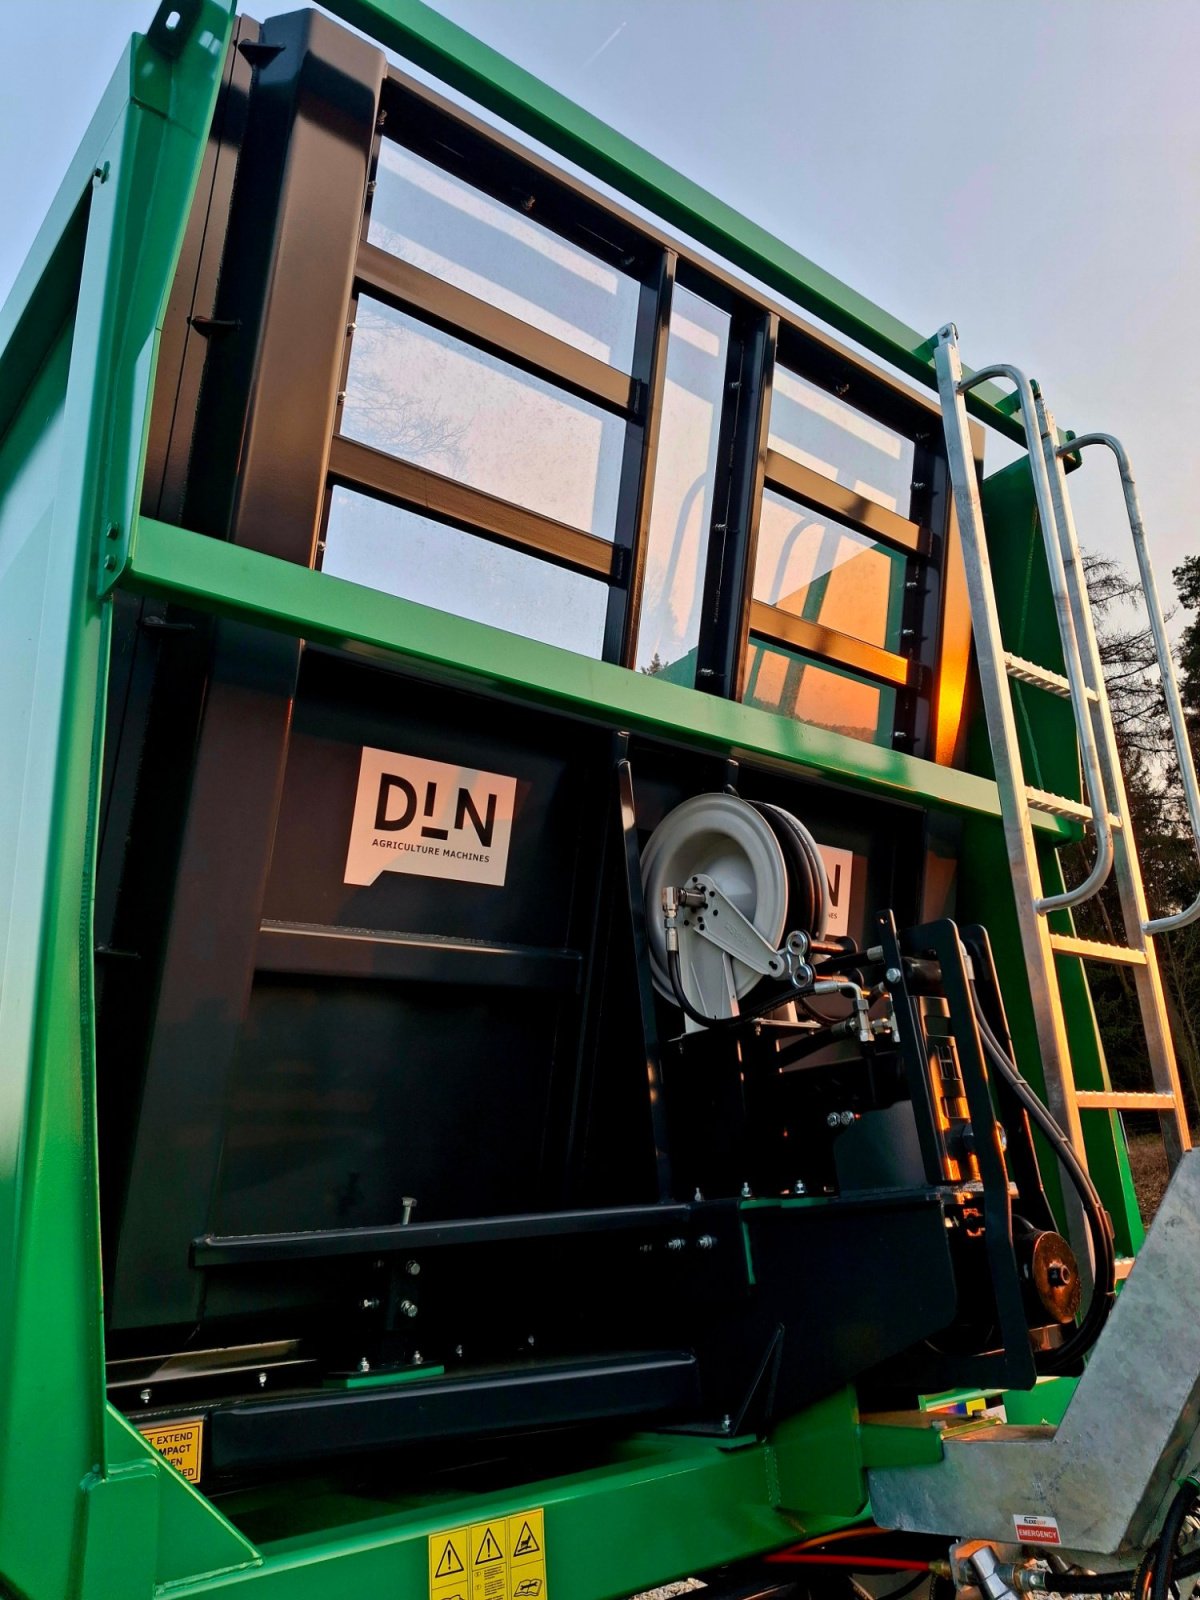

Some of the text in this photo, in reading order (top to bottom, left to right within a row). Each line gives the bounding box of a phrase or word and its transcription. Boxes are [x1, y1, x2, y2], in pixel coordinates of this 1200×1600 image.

[372, 838, 490, 863] AGRICULTURE MACHINES
[156, 1431, 193, 1445] EXTEND
[1018, 1529, 1057, 1539] EMERGENCY
